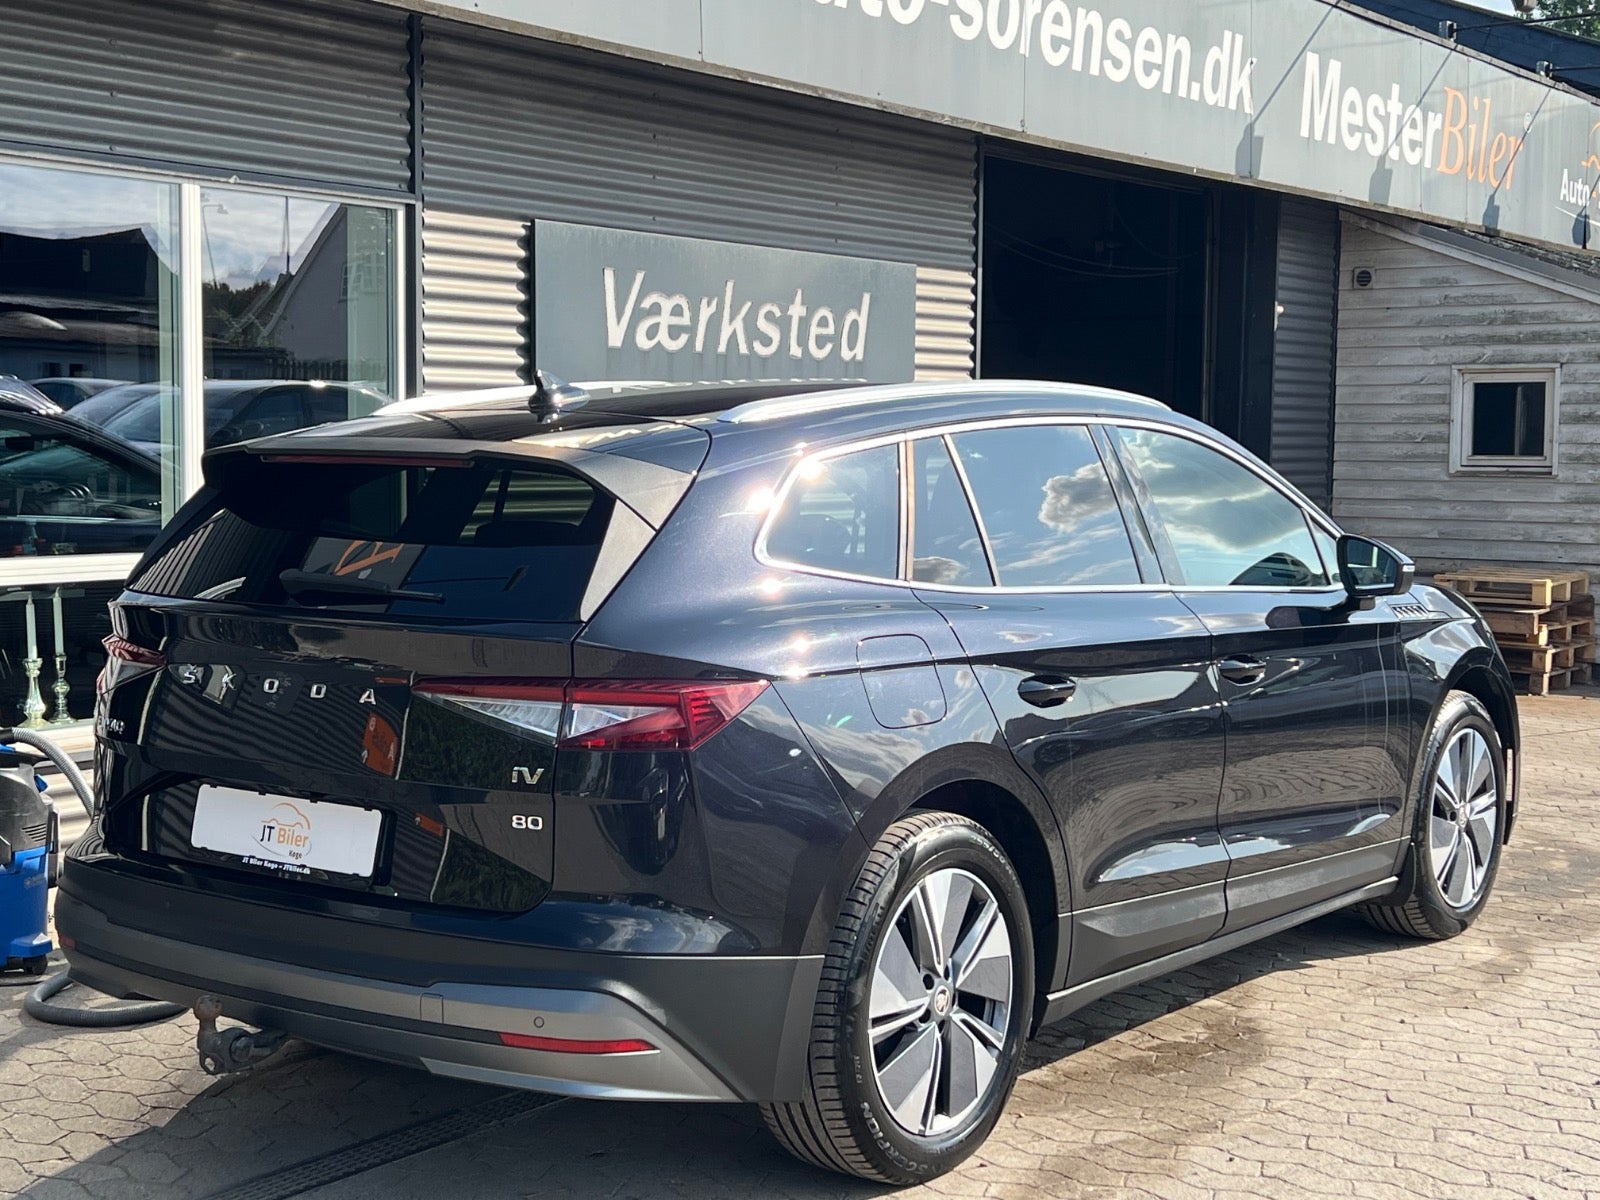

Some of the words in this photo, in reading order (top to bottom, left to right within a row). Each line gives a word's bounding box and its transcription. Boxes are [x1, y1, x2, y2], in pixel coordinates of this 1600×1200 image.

[814, 0, 1257, 115] sorensen.dk
[1300, 51, 1524, 190] MesterBiler
[602, 266, 871, 362] Værksted
[260, 825, 275, 842] JT
[277, 827, 309, 848] Biler
[511, 814, 543, 830] 80
